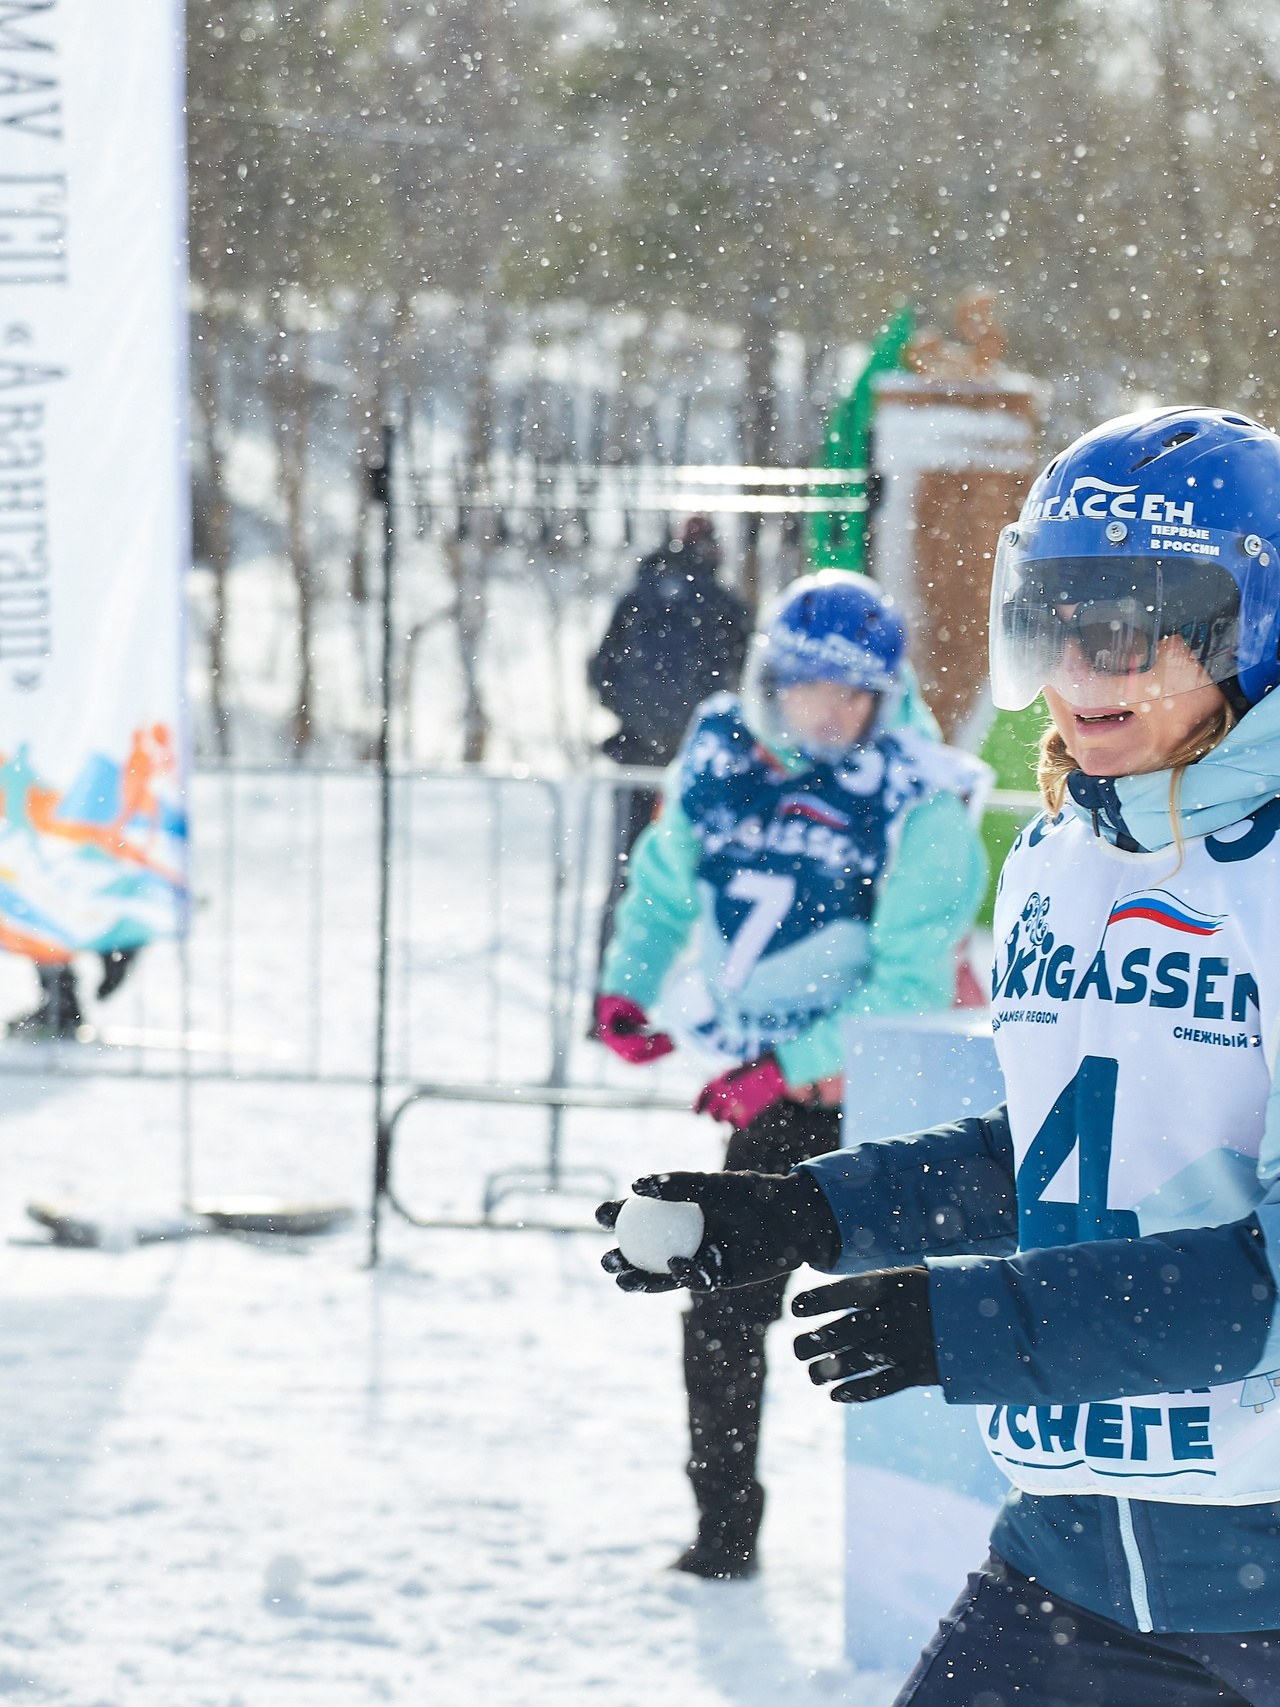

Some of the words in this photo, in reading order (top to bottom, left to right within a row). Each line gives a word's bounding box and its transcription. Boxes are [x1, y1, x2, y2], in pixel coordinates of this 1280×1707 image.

[1151, 525, 1210, 541] ПЕРВЫЕ
[1150, 539, 1161, 550] В
[1163, 540, 1220, 556] РОССИИ
[721, 873, 798, 992] 7
[1025, 1010, 1059, 1024] REGION
[1173, 1026, 1248, 1049] СНЕЖНЫЙ
[1017, 1055, 1141, 1253] 4
